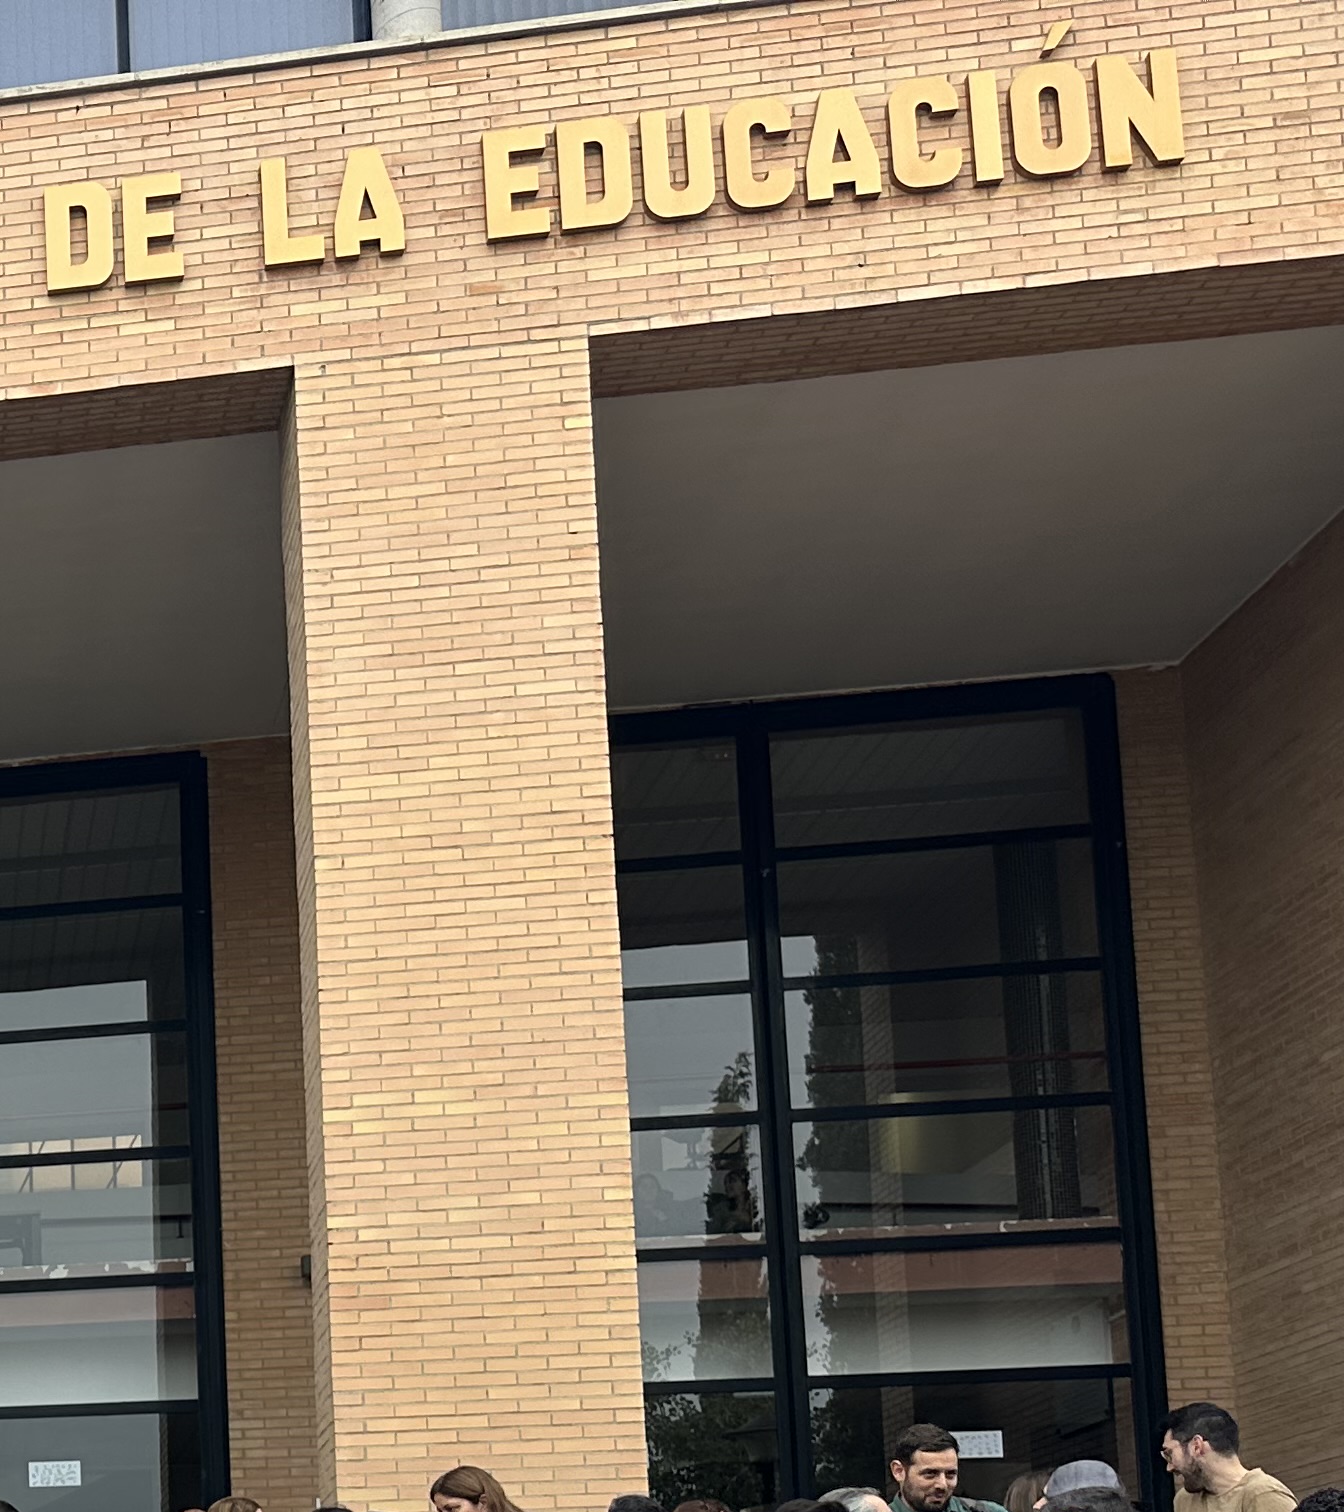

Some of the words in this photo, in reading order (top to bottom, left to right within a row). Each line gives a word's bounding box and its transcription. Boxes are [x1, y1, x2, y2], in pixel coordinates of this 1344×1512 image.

[44, 172, 185, 298] DE
[259, 145, 406, 272] LA
[481, 22, 1186, 246] EDUCACIÓN
